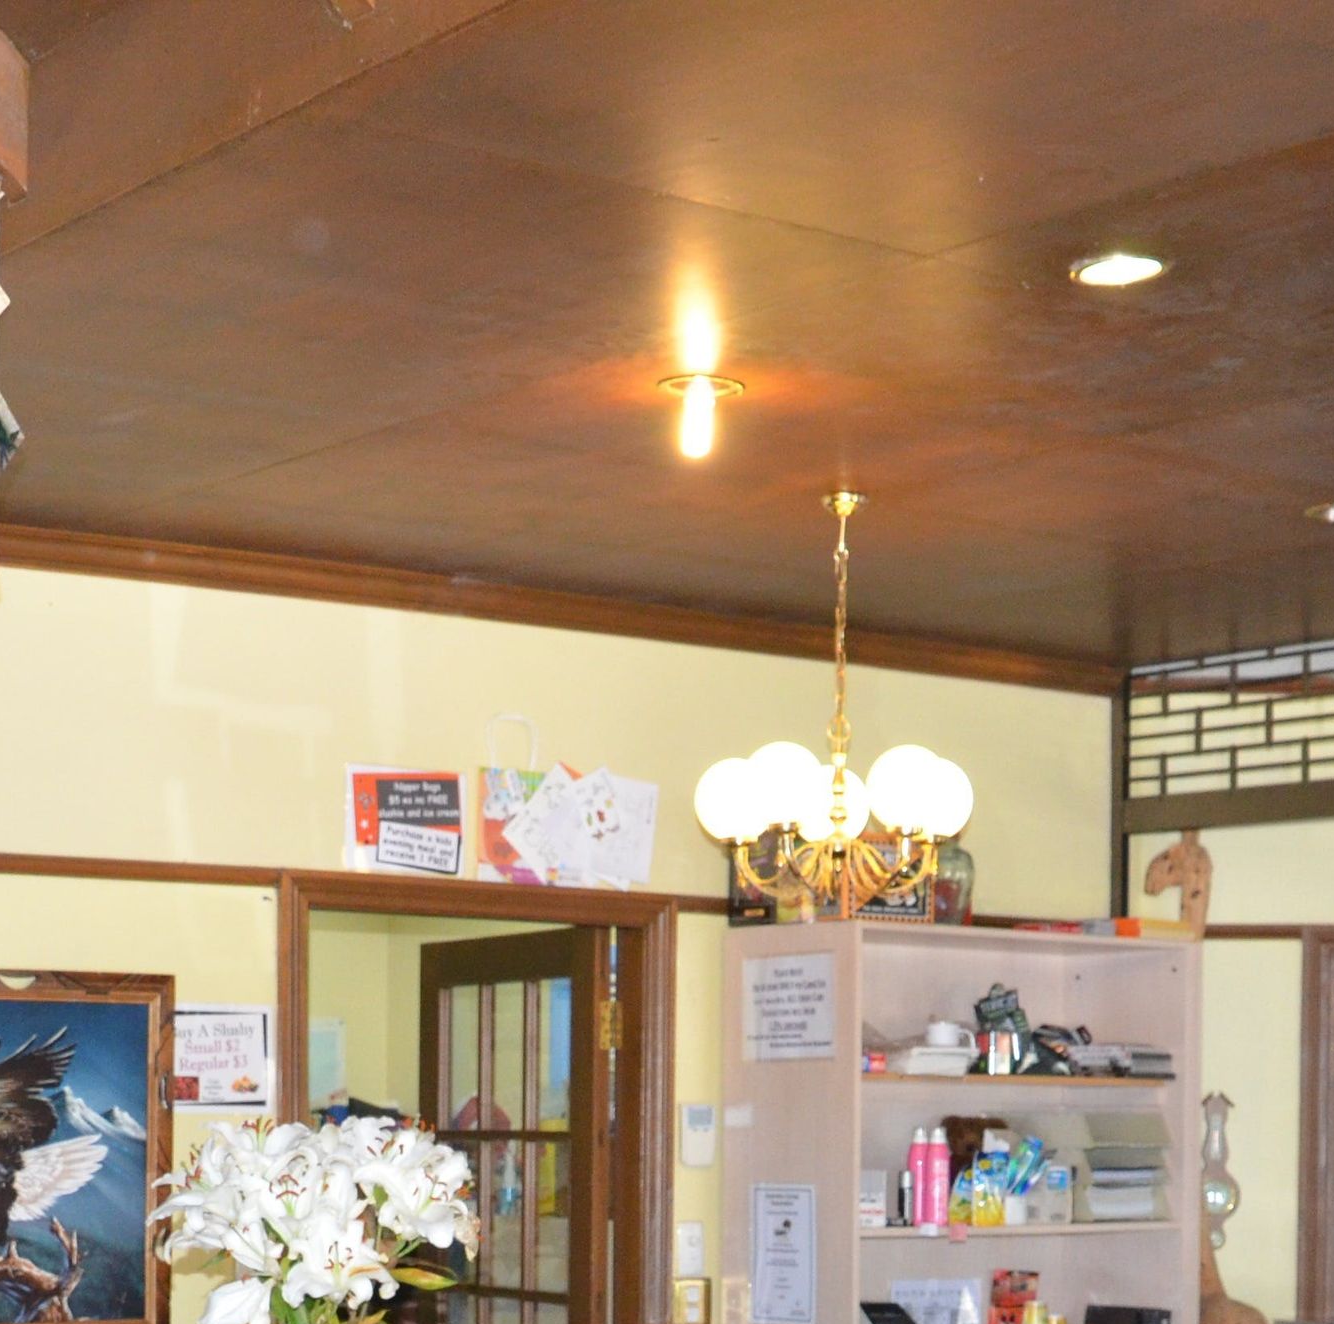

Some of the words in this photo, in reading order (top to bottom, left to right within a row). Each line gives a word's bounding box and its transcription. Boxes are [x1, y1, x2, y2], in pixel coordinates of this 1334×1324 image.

[197, 1023, 210, 1038] A
[184, 1040, 222, 1054] Small
[179, 1056, 228, 1072] Regular
